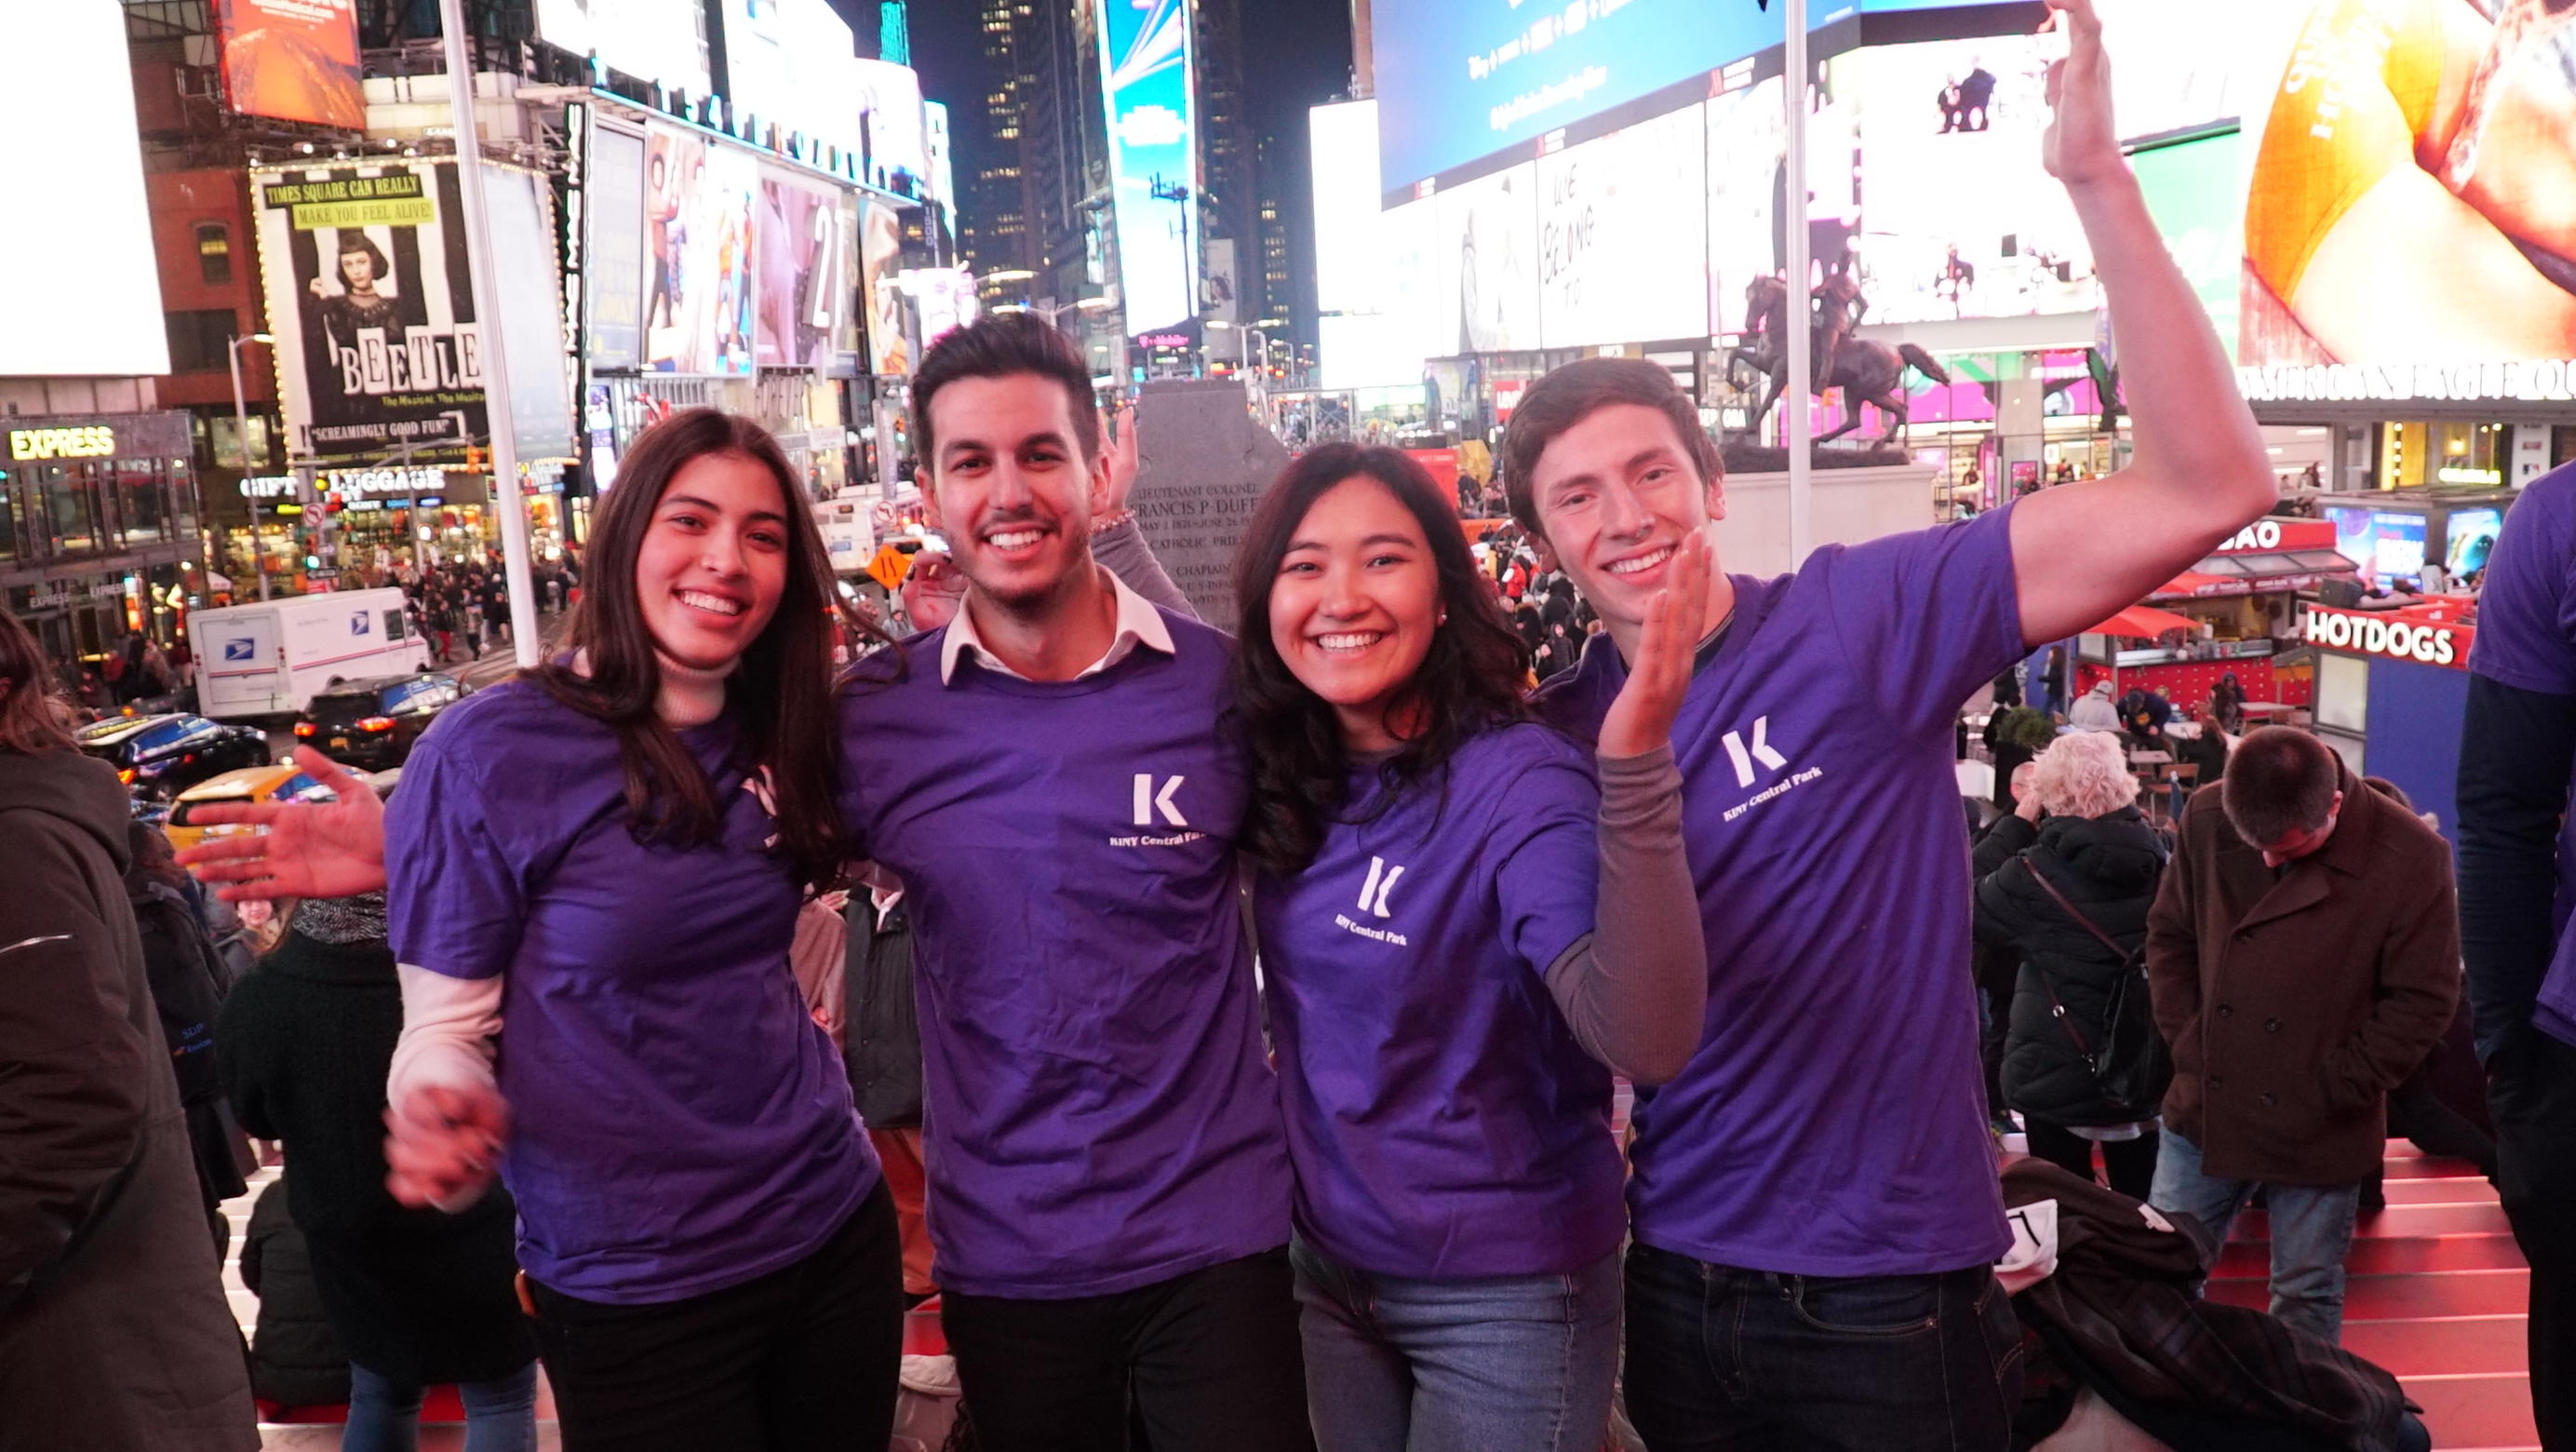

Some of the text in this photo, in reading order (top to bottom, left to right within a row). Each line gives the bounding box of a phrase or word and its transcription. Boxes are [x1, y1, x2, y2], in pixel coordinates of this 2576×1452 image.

[266, 175, 419, 204] TIMES SQUARE CAN REALLY
[299, 202, 432, 224] MAKE YOU FEEL ALIVE!
[339, 323, 486, 397] BEETLE
[389, 421, 419, 436] GOOD
[10, 425, 115, 461] EXPRESS
[239, 468, 447, 497] GIFT LUGGAGE
[1137, 482, 1260, 500] LIEUTENANT COLONEL
[1216, 497, 1260, 514] DUFF
[1149, 535, 1237, 550] CATHOLIC PRIE
[1175, 562, 1231, 576] CHAPLAIN
[2307, 610, 2455, 665] HOTDOGS
[1721, 715, 1788, 789] K
[1133, 773, 1188, 827] K
[1749, 778, 1792, 807] Central
[1791, 766, 1823, 786] Park
[1140, 834, 1184, 846] Central
[1349, 921, 1385, 941] Central
[1386, 931, 1407, 947] Park
